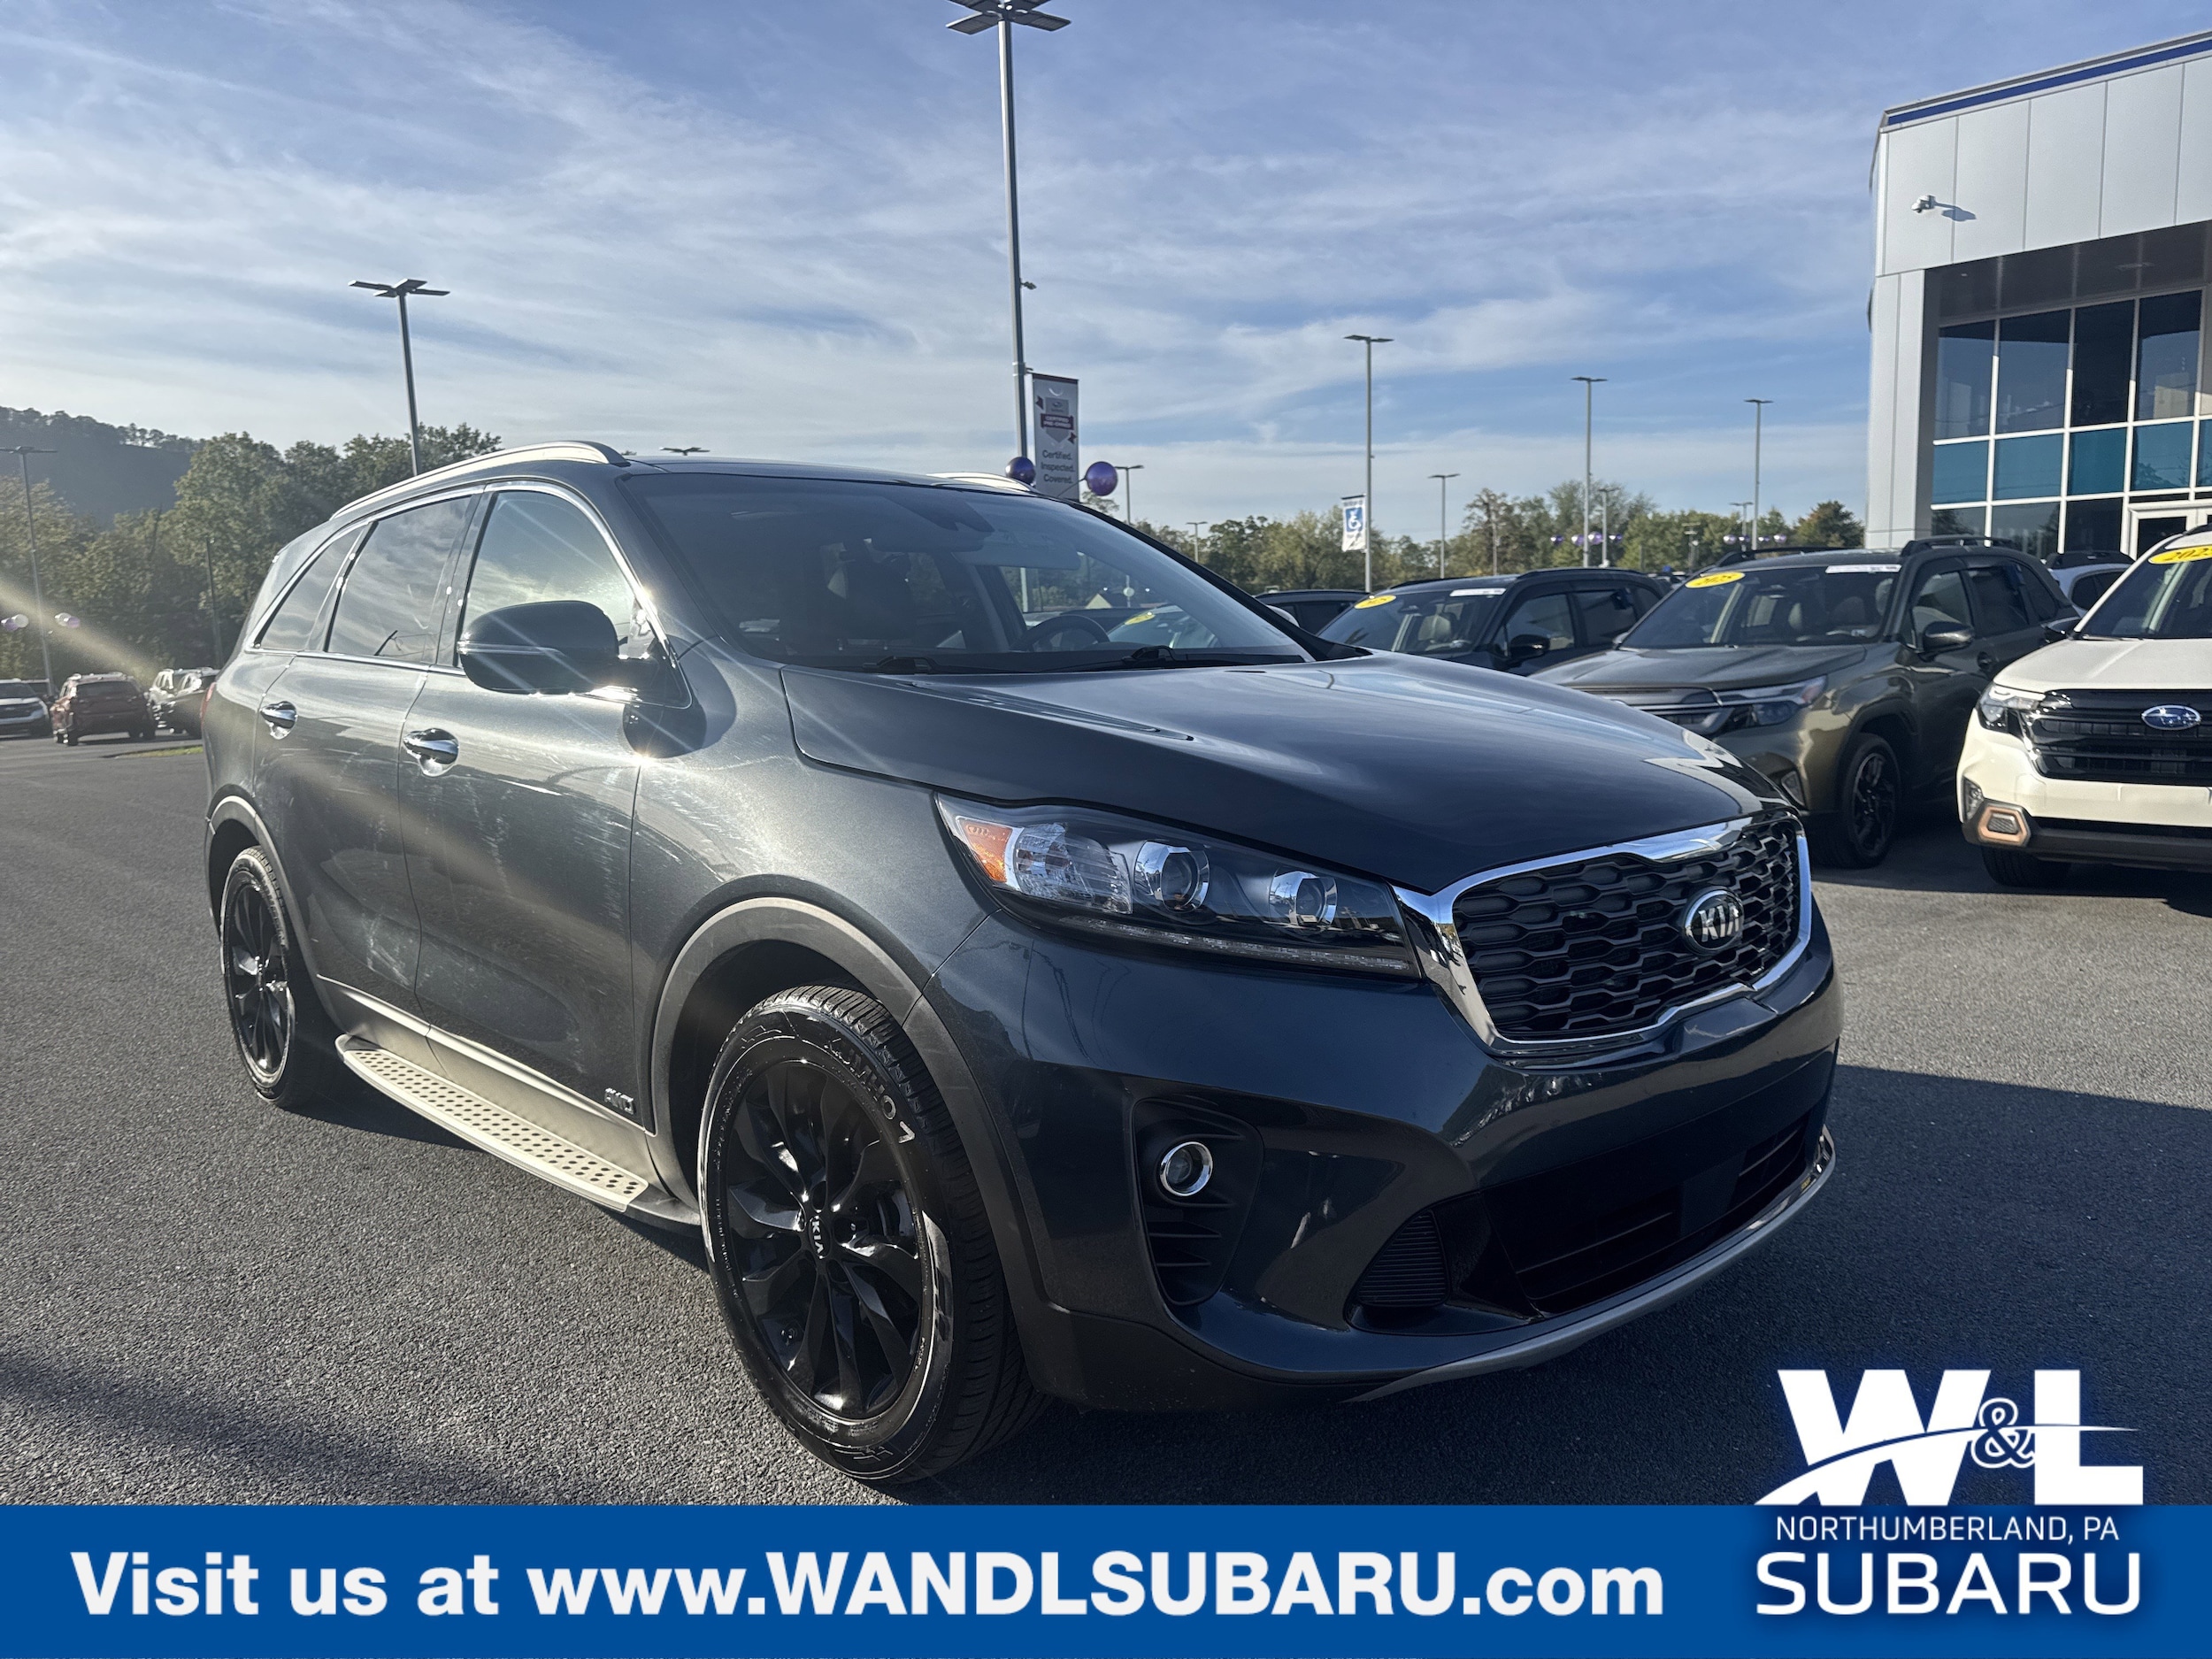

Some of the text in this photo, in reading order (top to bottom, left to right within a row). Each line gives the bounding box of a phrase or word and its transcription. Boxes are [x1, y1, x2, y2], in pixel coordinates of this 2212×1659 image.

[1041, 449, 1072, 460] Certified.
[1041, 462, 1075, 472] Inspected.
[1044, 474, 1073, 484] Covered.
[1699, 902, 1740, 942] KIA
[811, 1220, 824, 1254] KIA
